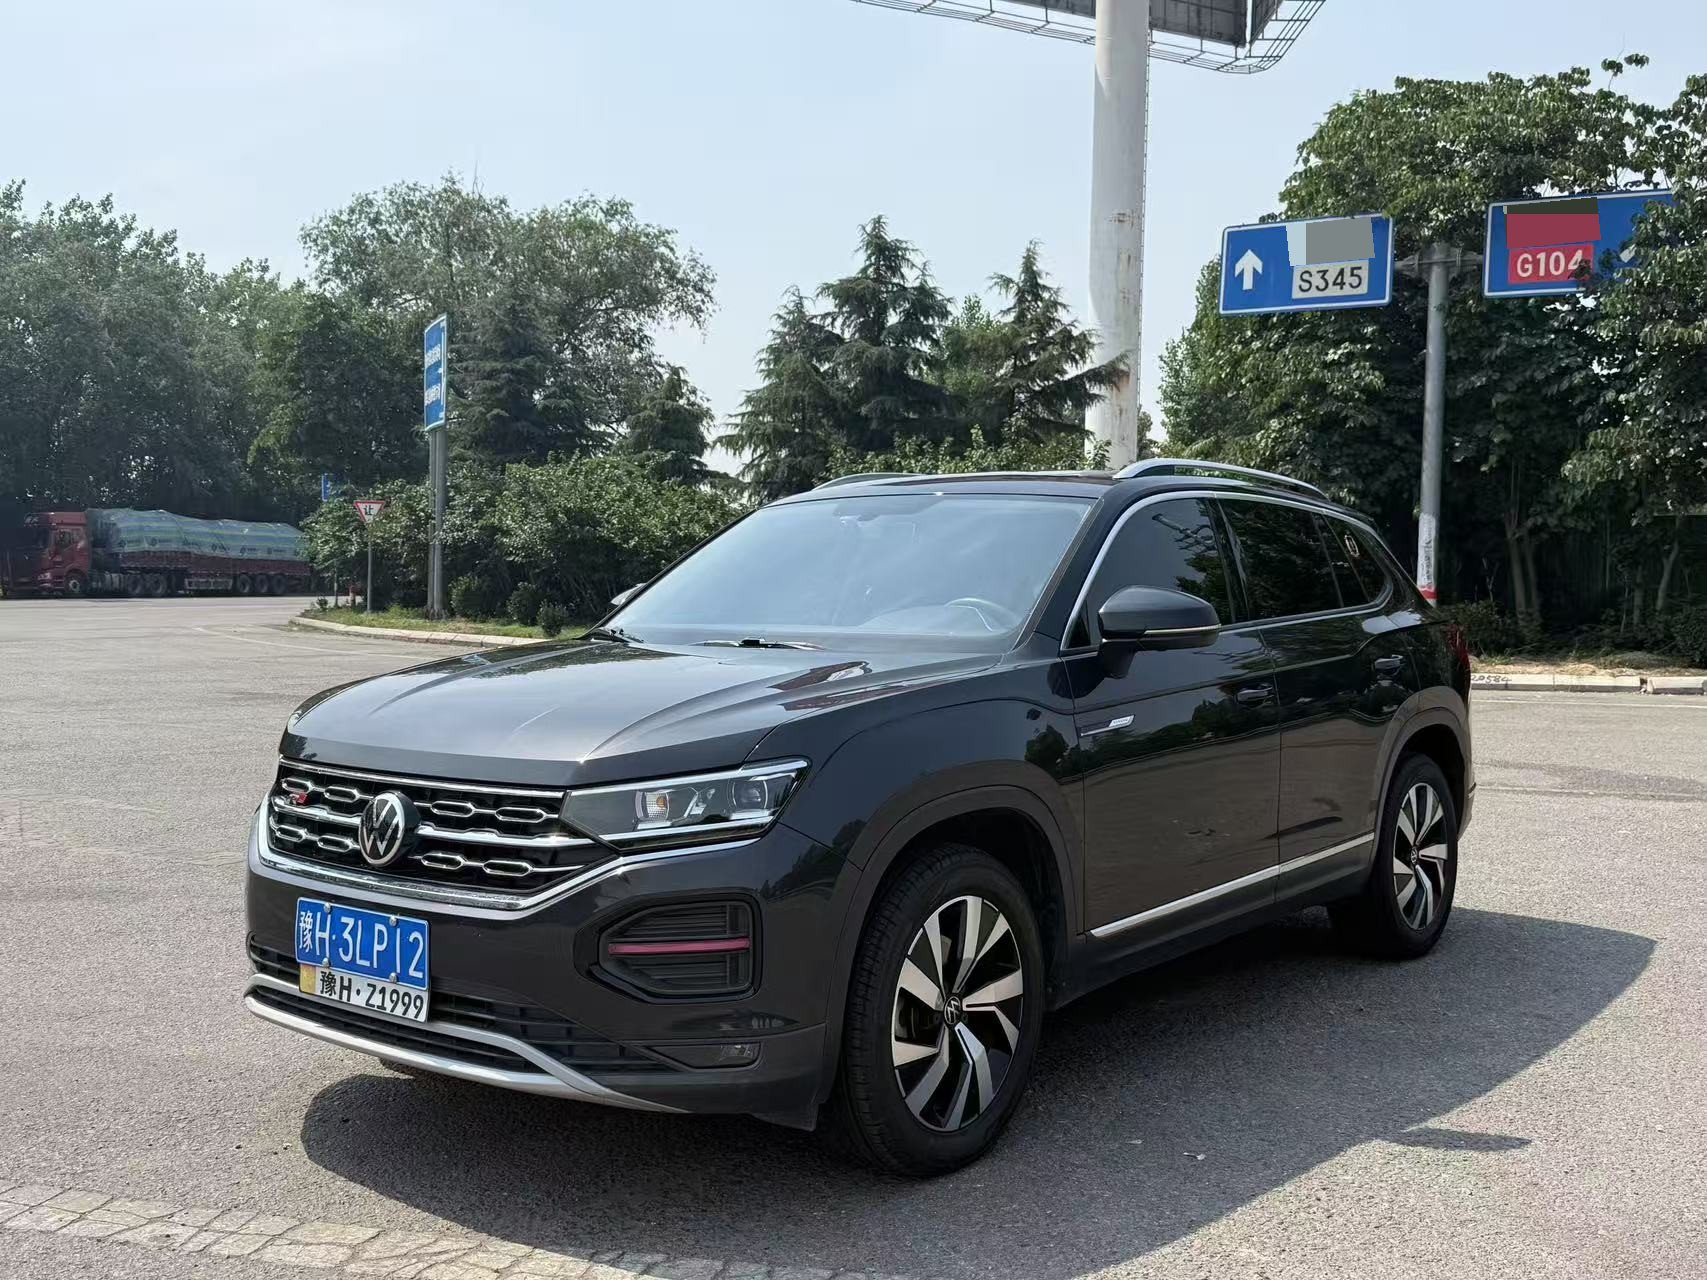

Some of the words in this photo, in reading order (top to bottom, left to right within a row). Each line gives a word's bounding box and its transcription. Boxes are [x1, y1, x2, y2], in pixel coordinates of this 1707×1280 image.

[1298, 266, 1363, 292] S345
[299, 910, 424, 979] 豫H·3LP12
[319, 970, 424, 1020] 豫H·Z1999
